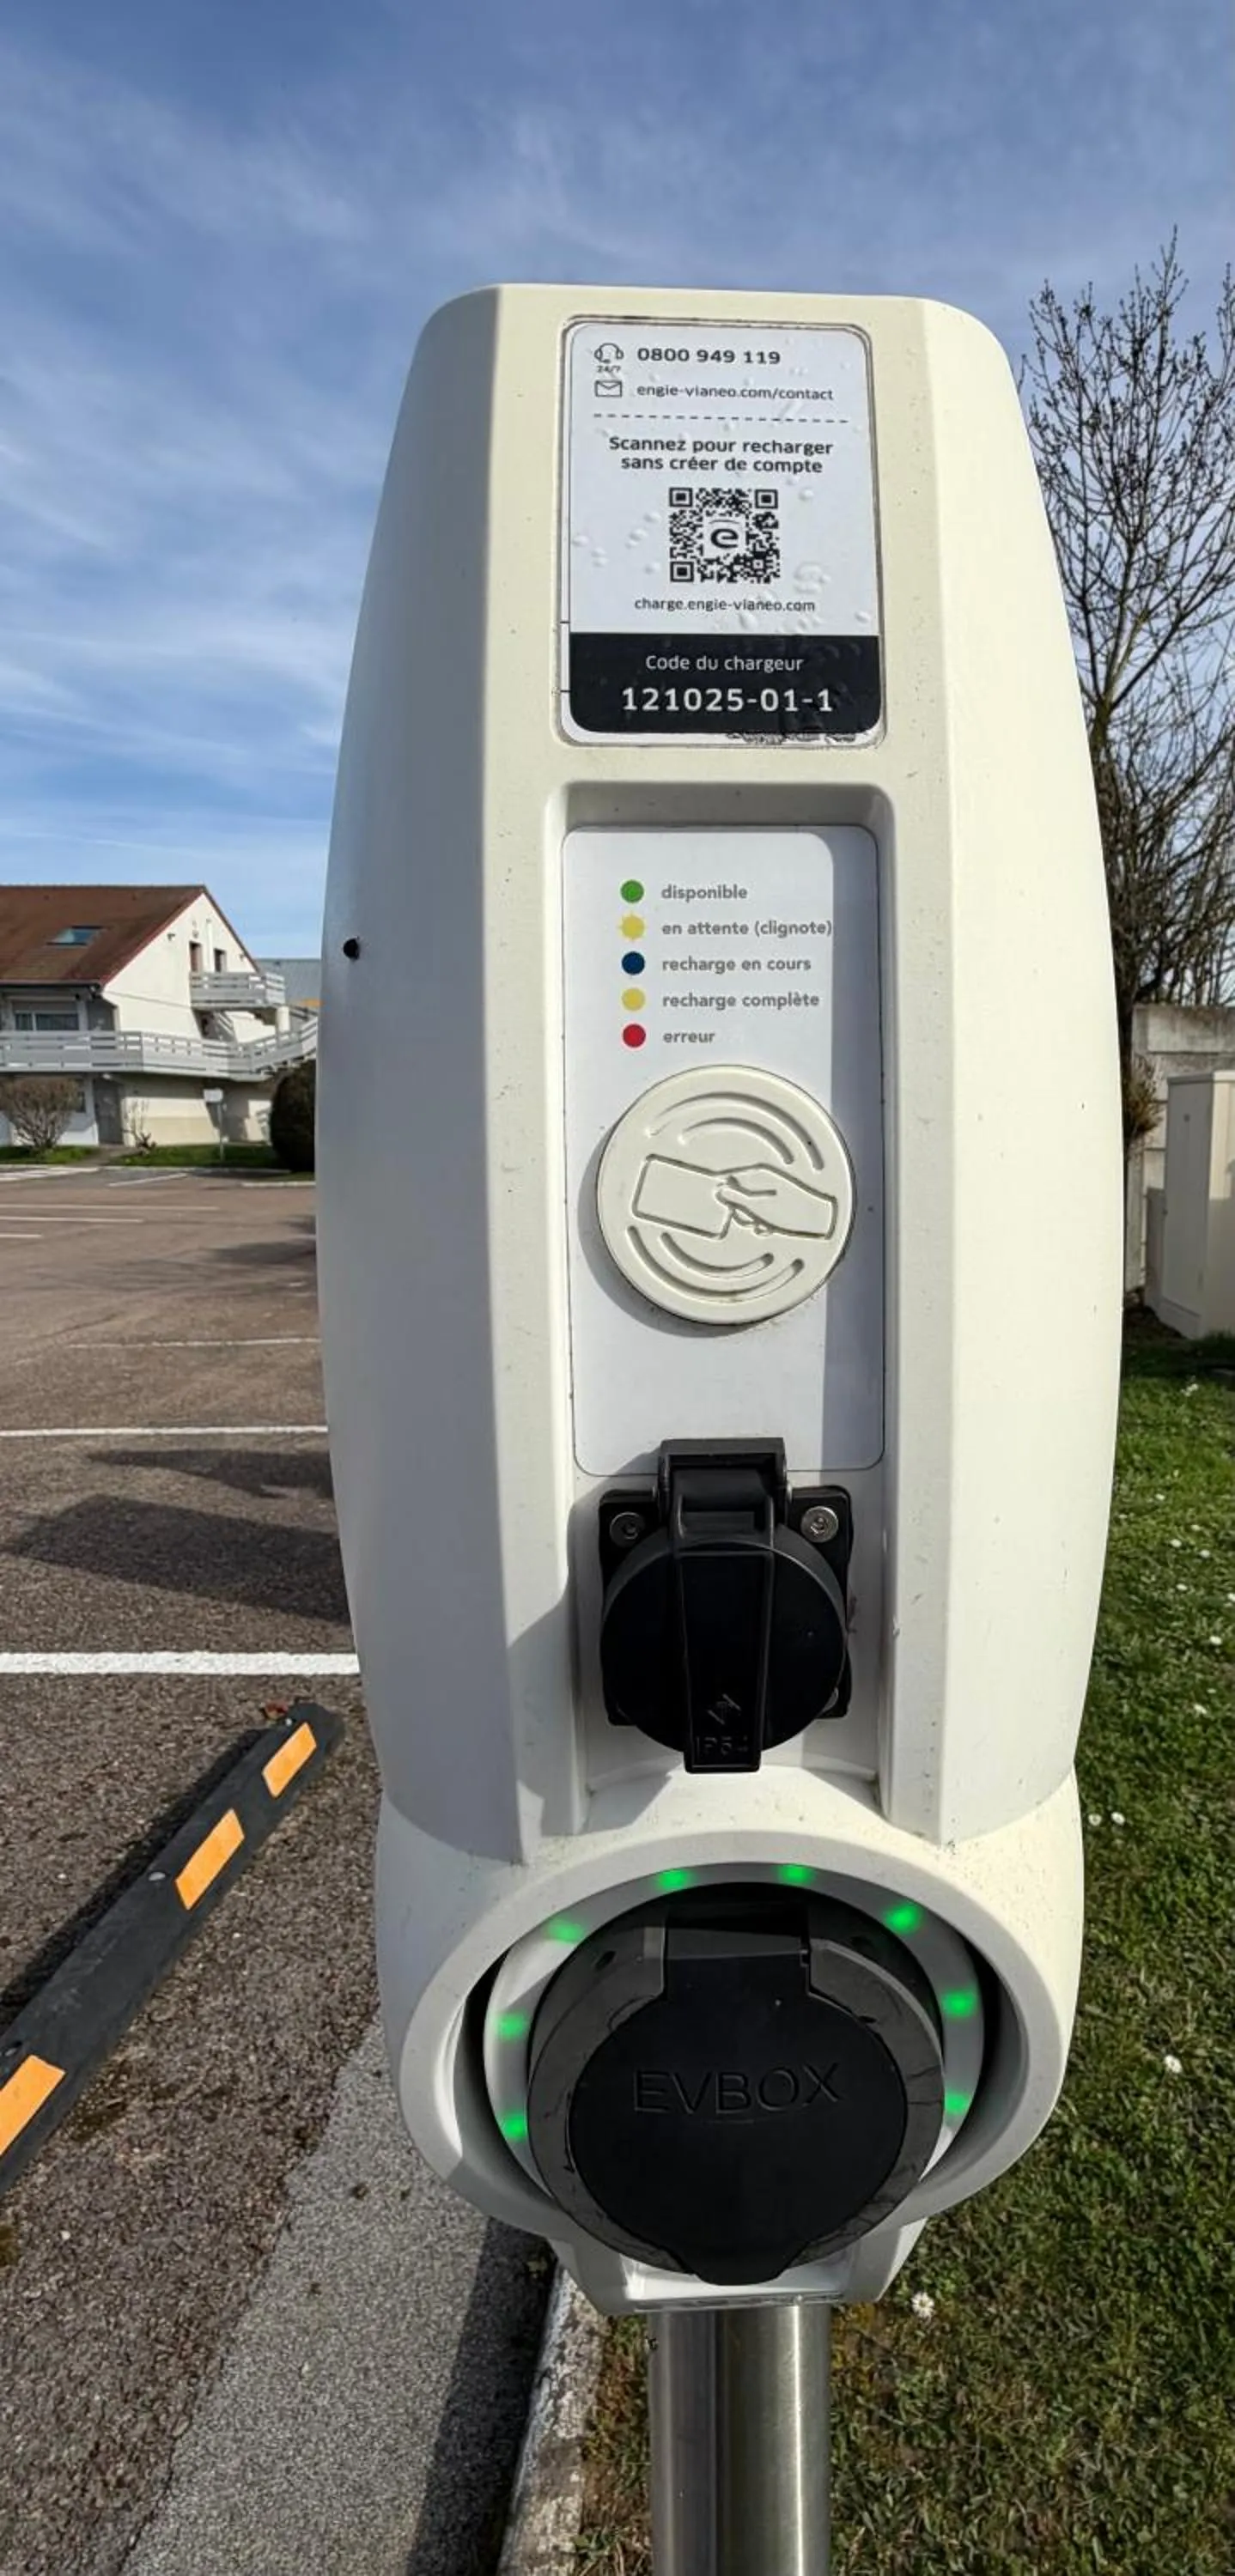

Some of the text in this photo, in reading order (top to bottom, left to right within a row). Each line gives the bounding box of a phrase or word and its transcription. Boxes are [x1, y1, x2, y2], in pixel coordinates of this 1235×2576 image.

[637, 348, 781, 365] 0800 949 119
[636, 384, 834, 401] engie-vianeo.com/contact
[609, 436, 834, 456] Scannez pour recharger
[621, 456, 823, 474] sans créer de compte
[634, 597, 816, 613] charge.engie-vianeo.com
[646, 655, 804, 674] Code du chargeur
[622, 687, 833, 713] 121025-01-1
[661, 884, 748, 902] disponible
[662, 920, 833, 938] en attente (clignote)
[662, 956, 812, 974] recharge en cours
[662, 992, 820, 1011] recharge complète
[662, 1031, 715, 1043] erreur
[633, 2063, 842, 2115] EVBOX
